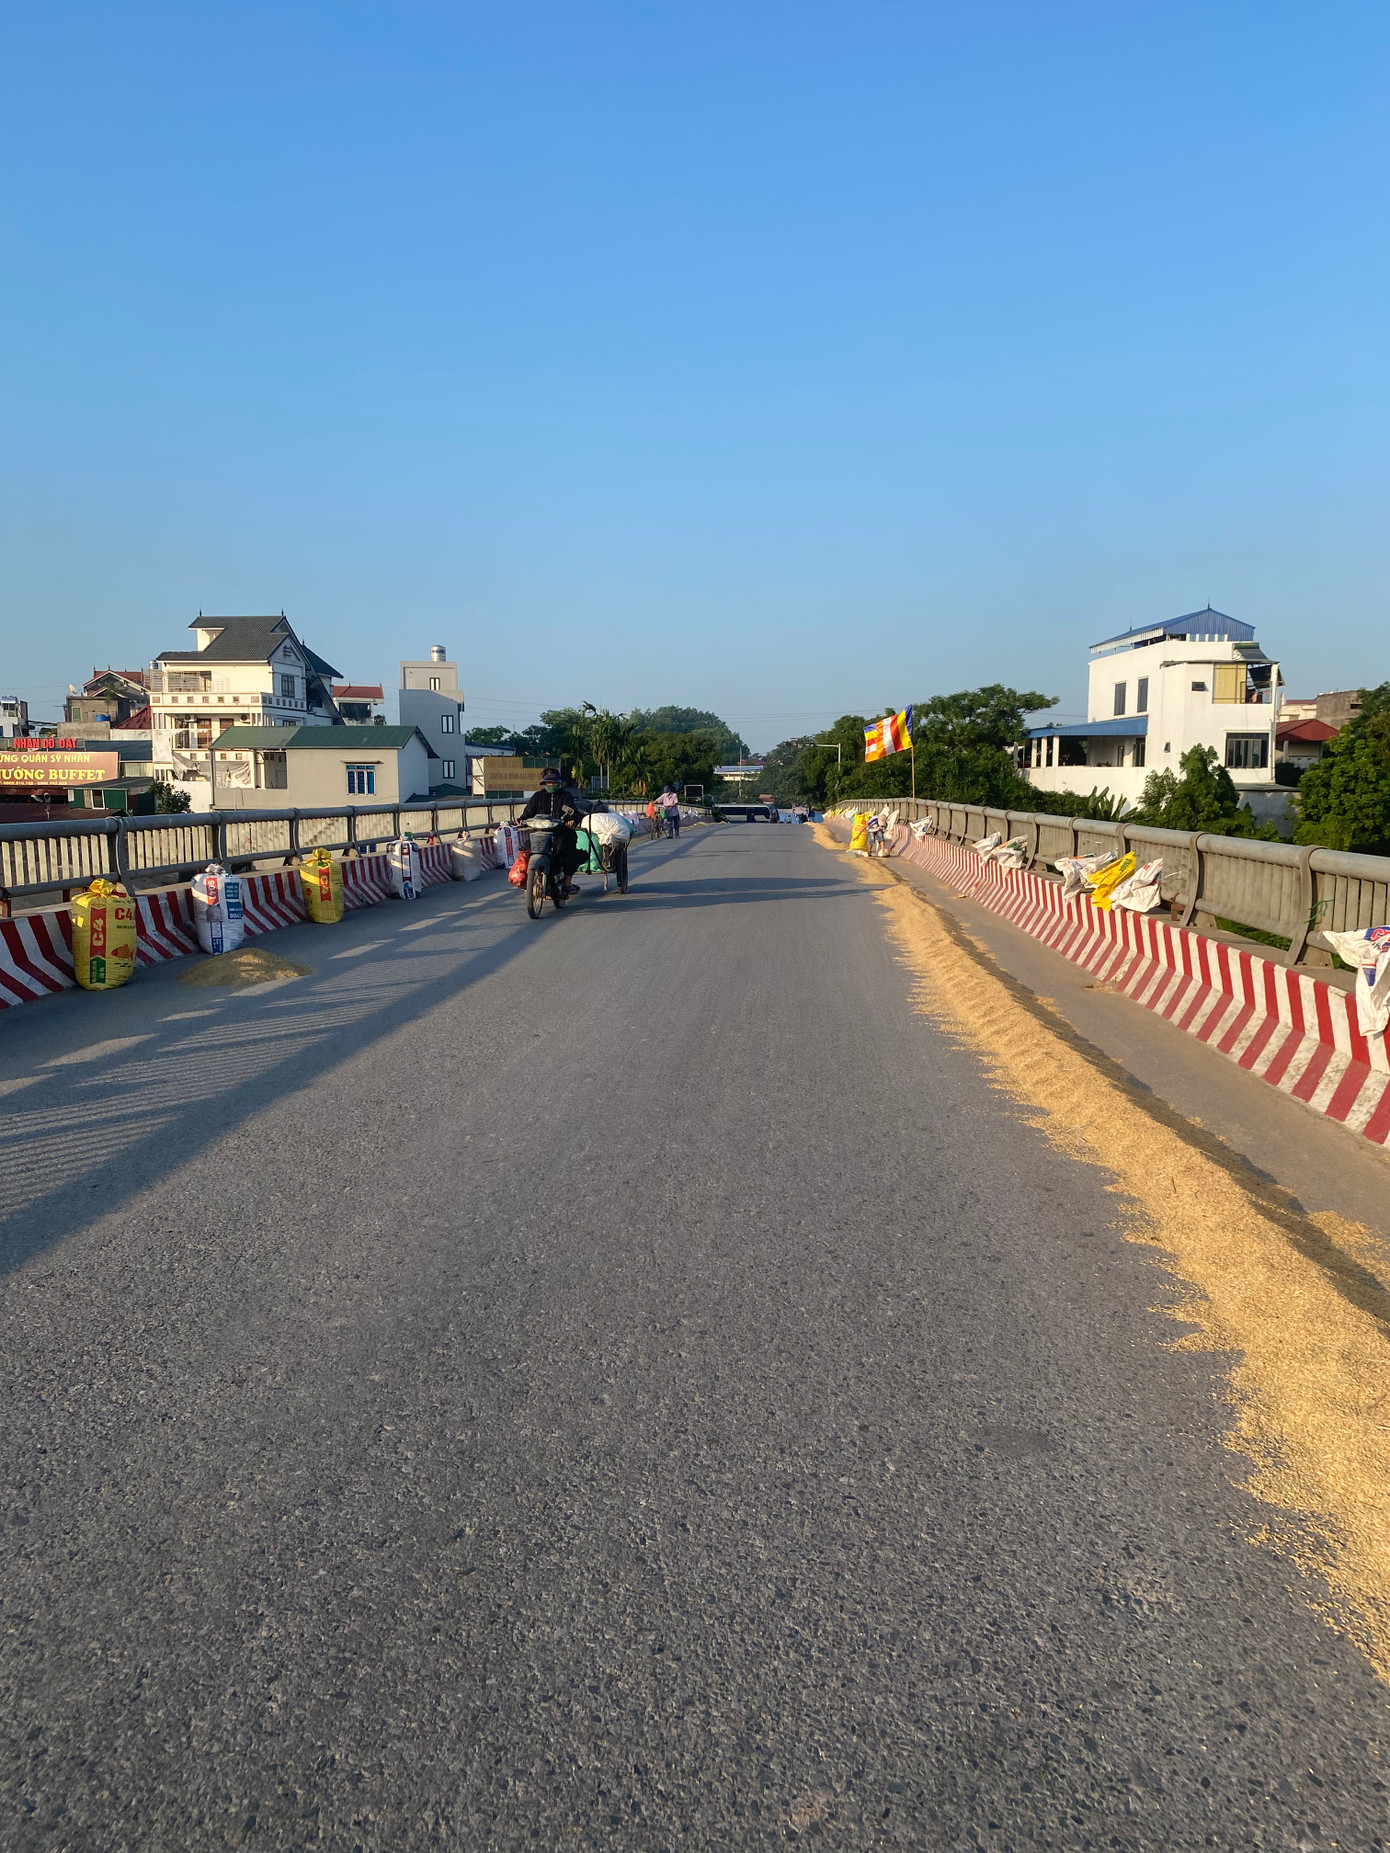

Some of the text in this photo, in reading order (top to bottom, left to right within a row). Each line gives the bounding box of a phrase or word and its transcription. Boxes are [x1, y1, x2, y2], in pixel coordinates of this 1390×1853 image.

[21, 752, 48, 763] QUÁN
[0, 766, 105, 780] ƯỚNG BUFFET
[93, 917, 104, 947] C4
